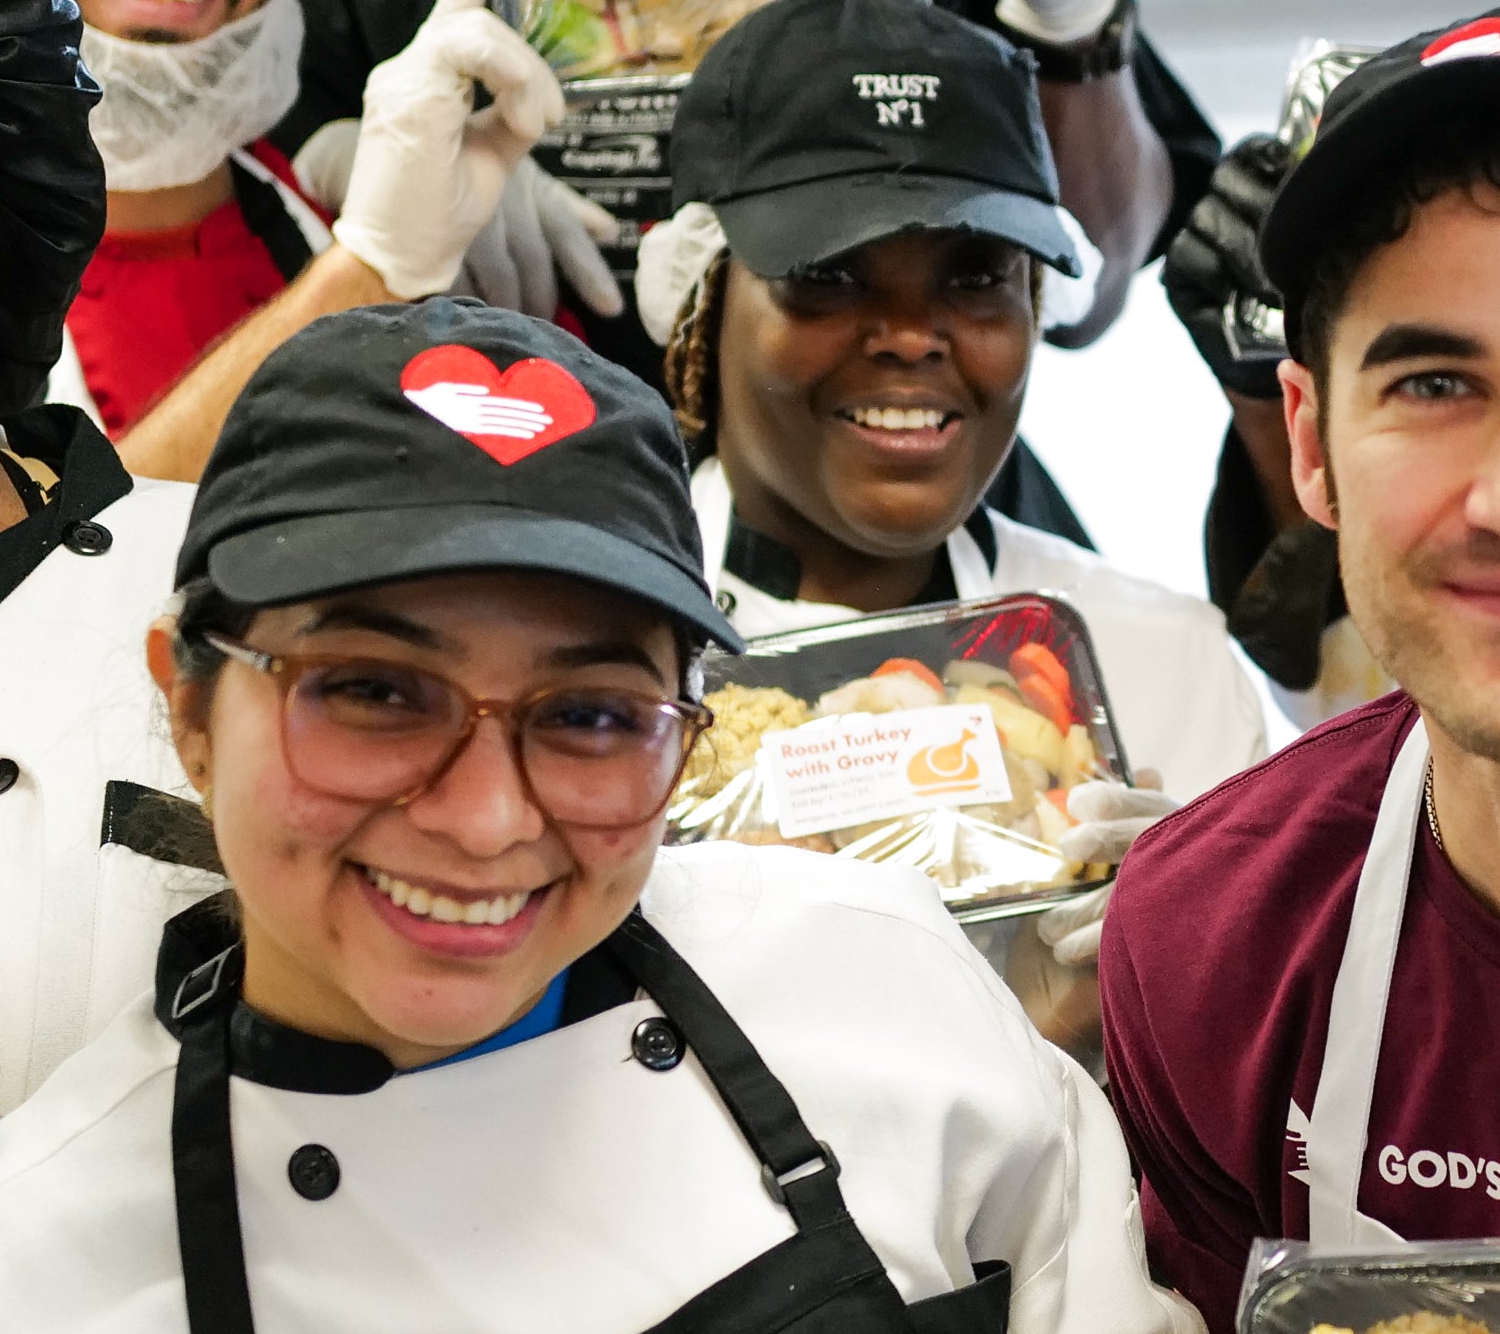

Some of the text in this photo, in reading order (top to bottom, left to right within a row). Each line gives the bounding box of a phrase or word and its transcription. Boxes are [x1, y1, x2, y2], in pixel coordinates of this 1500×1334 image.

[852, 74, 941, 100] TRUST
[780, 728, 912, 759] Roast Turkey
[785, 750, 898, 779] with Gravy
